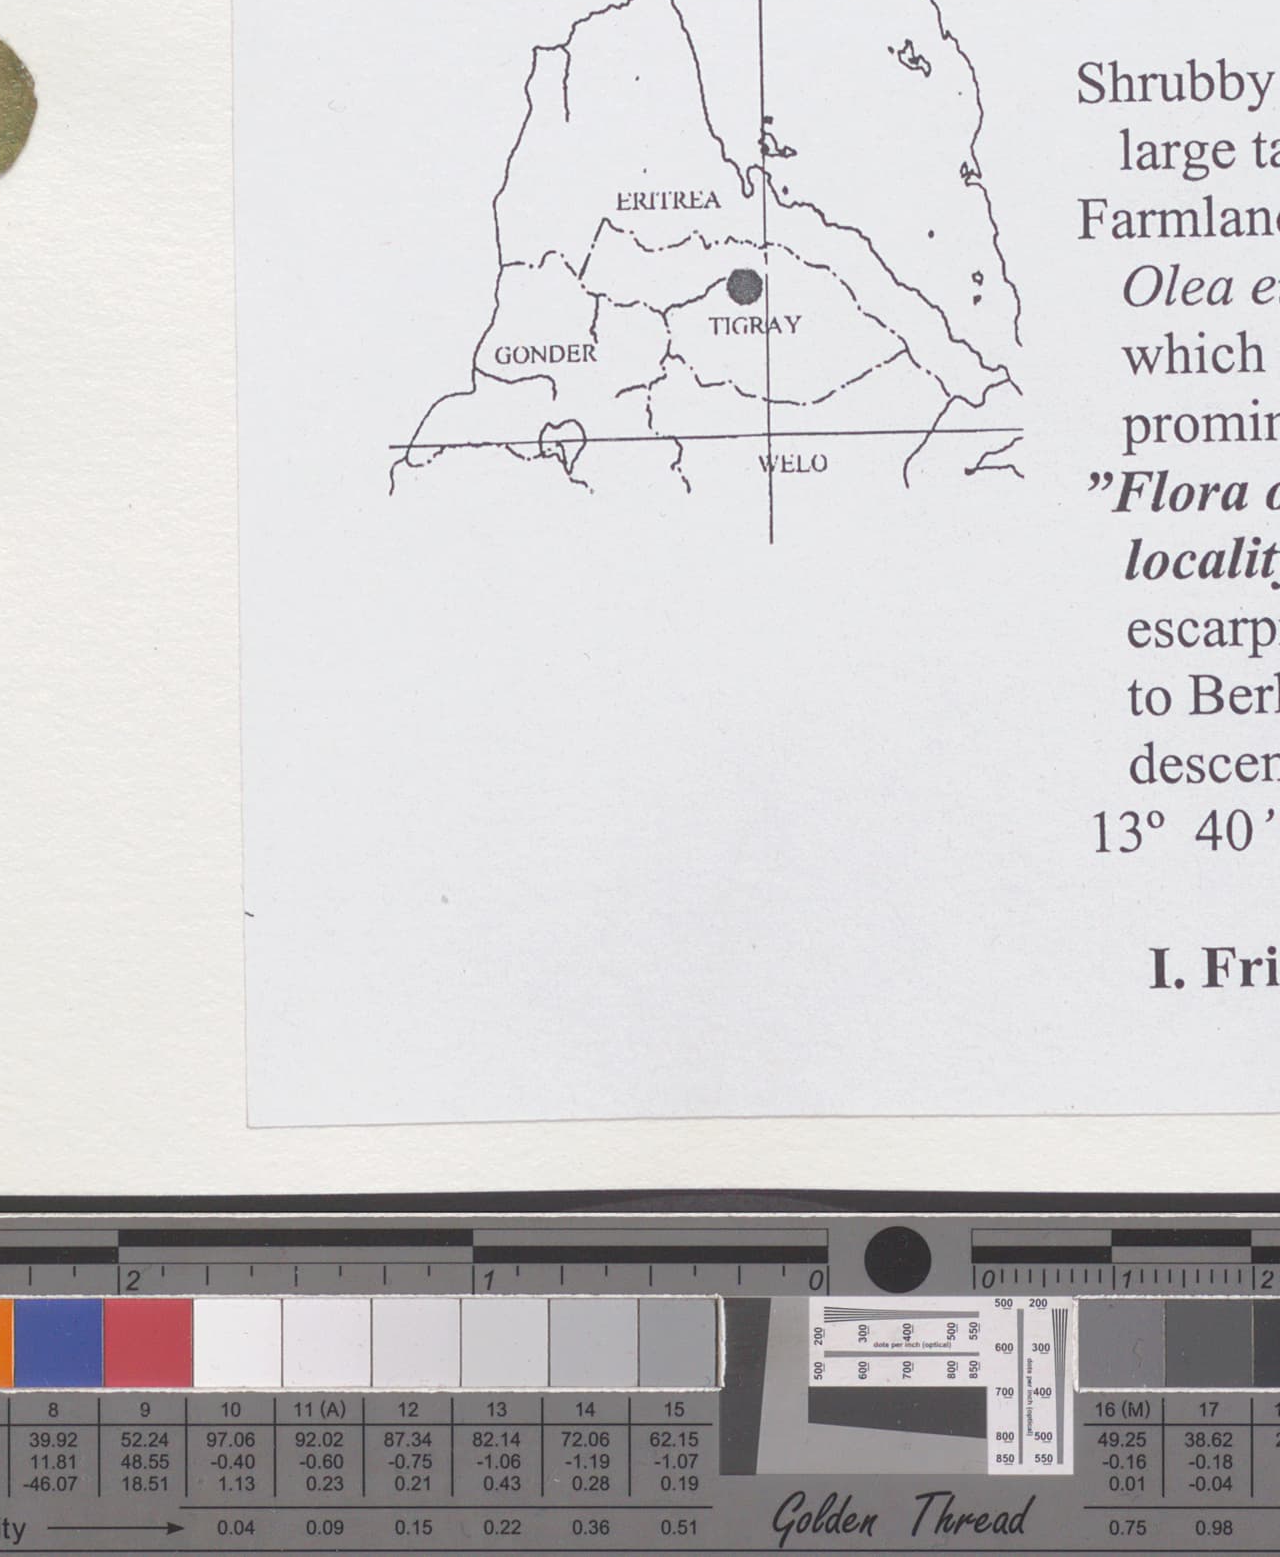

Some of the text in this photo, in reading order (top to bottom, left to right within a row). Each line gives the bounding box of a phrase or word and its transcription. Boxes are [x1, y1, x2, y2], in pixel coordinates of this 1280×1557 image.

[1077, 57, 1276, 113] Shrubby
[1119, 127, 1236, 183] large
[616, 190, 722, 212] ERITREA
[1123, 263, 1234, 308] Olea
[708, 314, 803, 335] TIGRAY
[494, 344, 598, 365] GONDER
[1120, 329, 1267, 376] which
[758, 453, 829, 475] WELO
[1127, 678, 1172, 717] to
[1148, 947, 1186, 990] I.
[922, 1341, 952, 1349] (optical)
[772, 1491, 1036, 1548] Golden Thread
